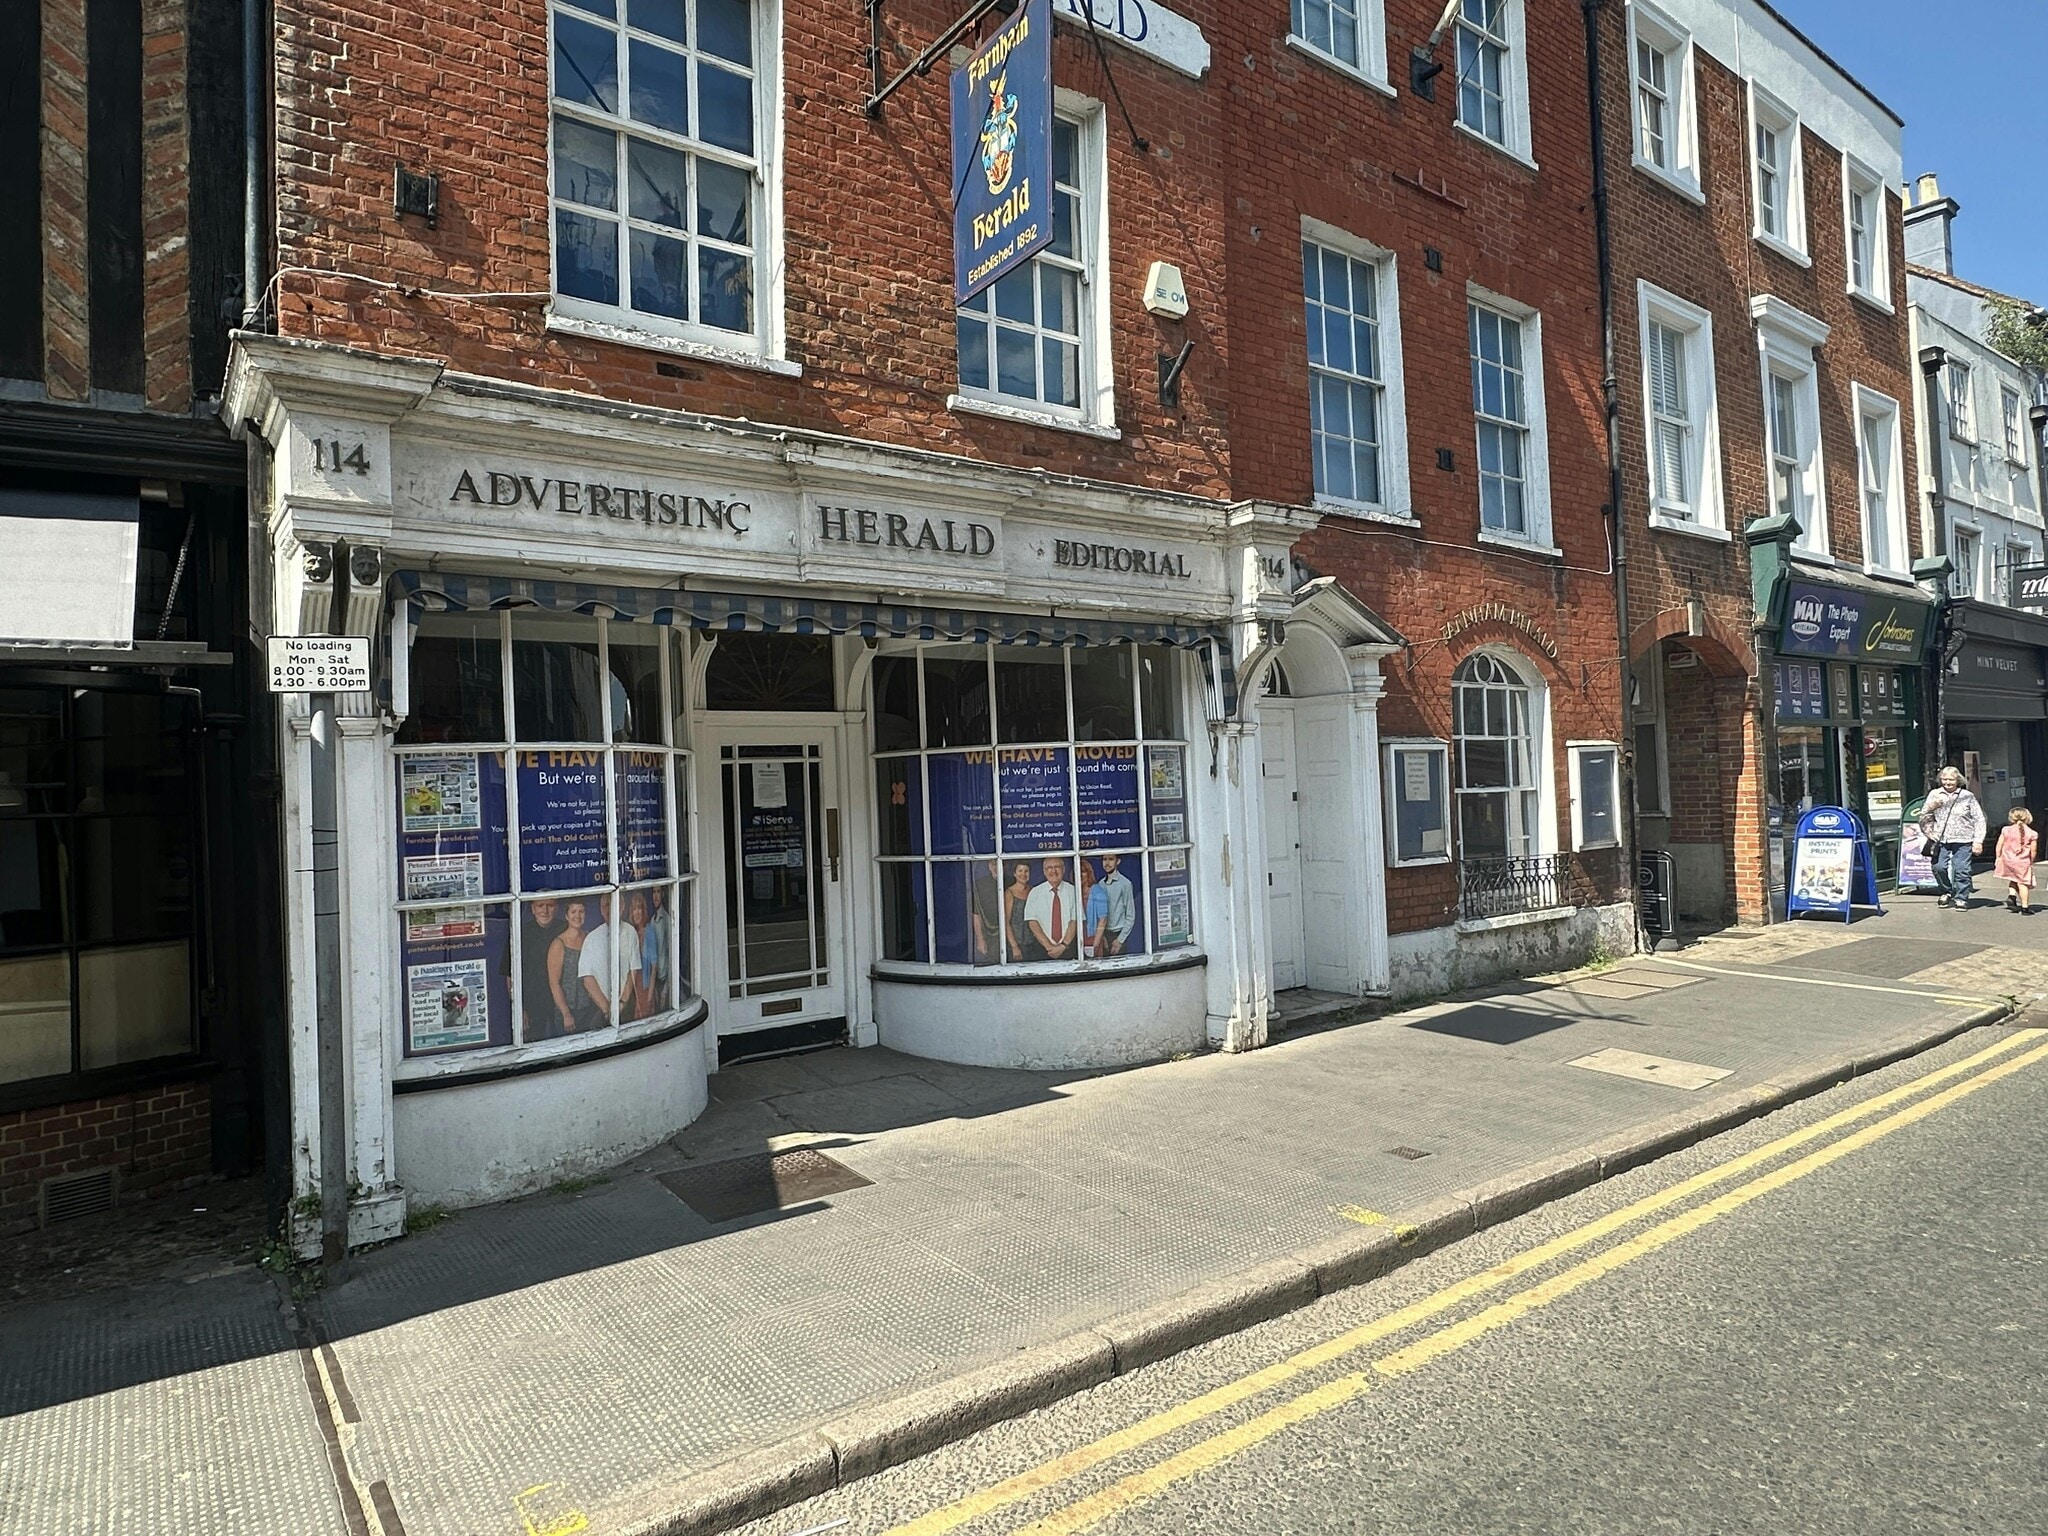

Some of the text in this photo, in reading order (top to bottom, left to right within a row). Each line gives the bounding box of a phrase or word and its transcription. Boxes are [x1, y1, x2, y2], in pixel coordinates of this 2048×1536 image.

[967, 223, 1038, 286] Established 1892
[313, 438, 370, 476] 114
[817, 505, 995, 556] HERALD
[1053, 538, 1192, 578] EDITORIAL
[1261, 556, 1285, 579] 114
[1793, 600, 1823, 622] MAX
[1828, 604, 1858, 622] The Photo
[1829, 624, 1851, 642] Expert
[285, 641, 352, 651] No loading
[289, 655, 316, 664] Mon
[328, 655, 350, 664] Sat
[1976, 656, 2018, 672] MINT VELVET
[273, 666, 304, 676] 8.00
[317, 666, 365, 676] 9.30am
[273, 678, 305, 687] 4.30
[317, 678, 366, 688] 6.00pm
[549, 751, 600, 768] HAV
[1001, 747, 1055, 763] HAVE
[999, 767, 1010, 776] ut
[1012, 764, 1041, 775] we're
[1044, 764, 1060, 776] just
[1066, 761, 1100, 773] aound
[1101, 761, 1115, 772] the
[539, 772, 560, 785] But
[563, 771, 597, 784] we're
[491, 825, 505, 833] You
[521, 823, 537, 833] pick
[538, 825, 547, 833] up
[548, 824, 562, 832] your
[563, 821, 584, 831] copies
[1043, 830, 1065, 838] Herald
[548, 835, 562, 844] The
[563, 833, 578, 843] Old
[579, 832, 599, 841] Court
[1038, 841, 1063, 850] 01252
[555, 848, 570, 856] And
[532, 863, 547, 872] See
[548, 864, 563, 873] you
[586, 860, 600, 868] The
